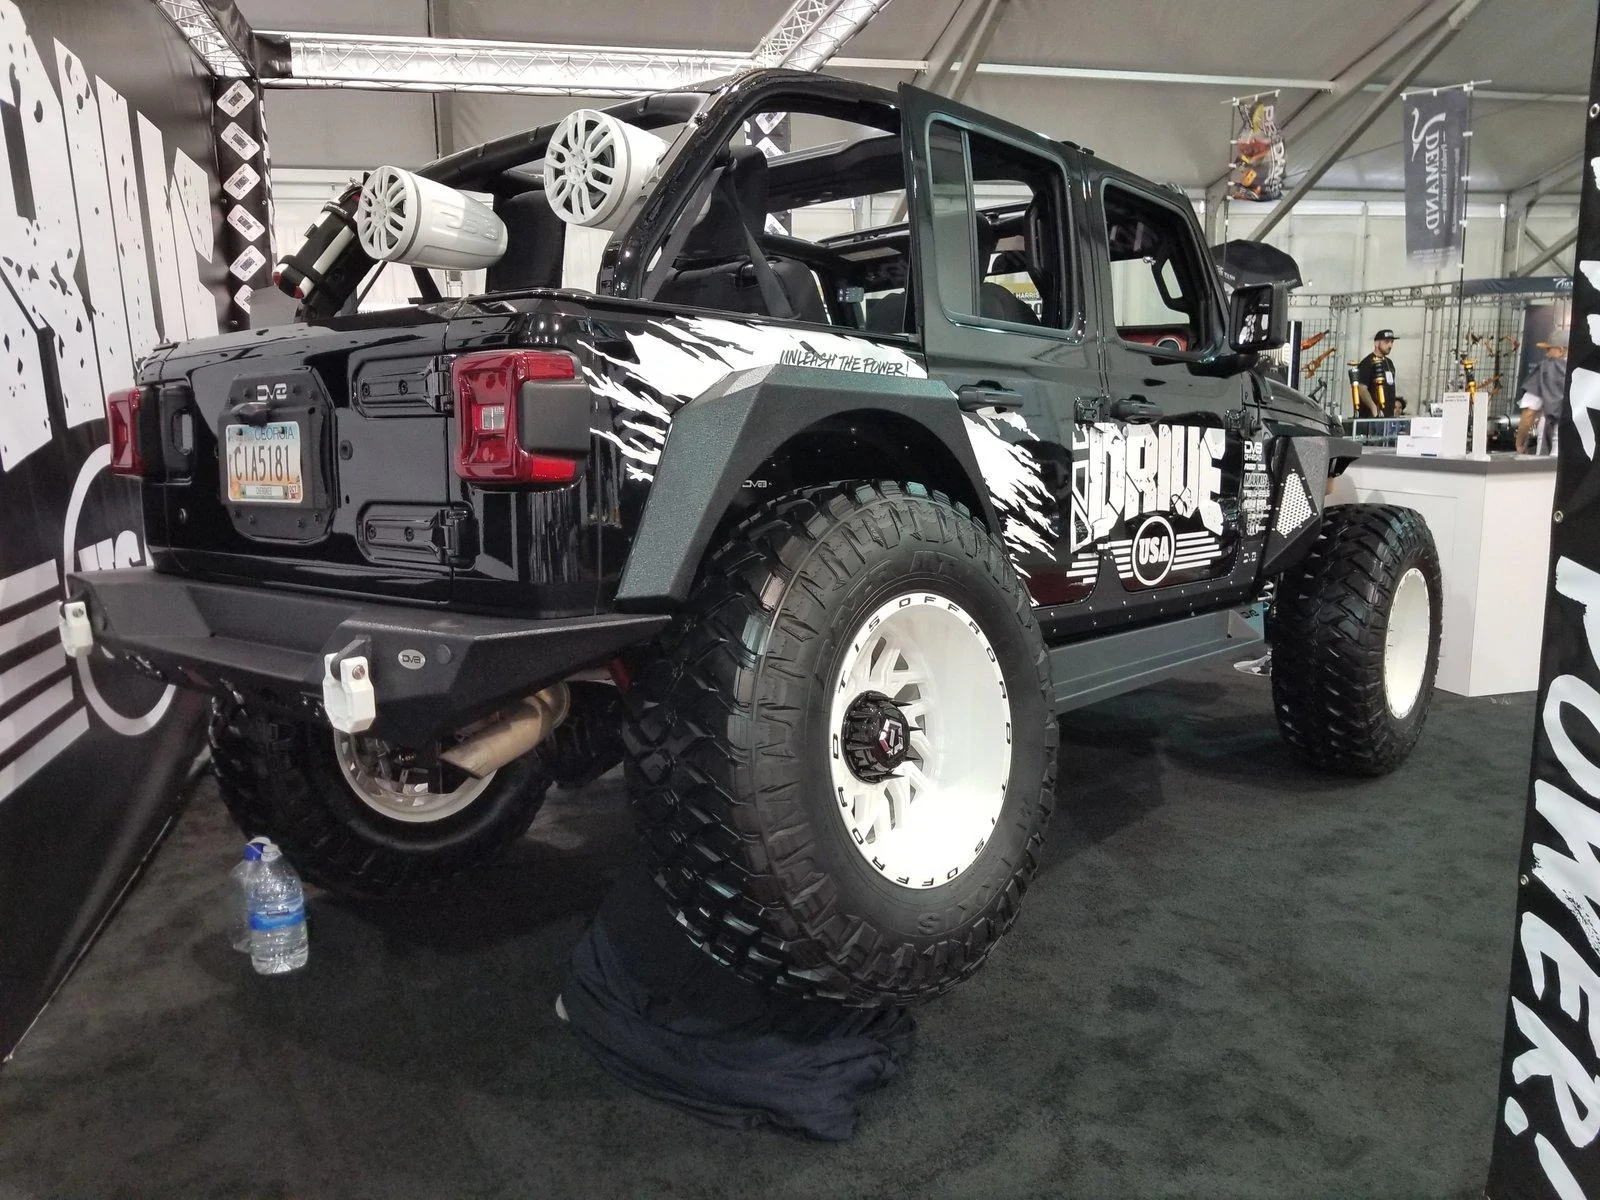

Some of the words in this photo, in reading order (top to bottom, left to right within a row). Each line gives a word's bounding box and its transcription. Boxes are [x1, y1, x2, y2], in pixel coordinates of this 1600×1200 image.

[779, 349, 837, 369] UNLEASH
[839, 355, 861, 371] THE
[863, 357, 909, 377] POWER!
[233, 444, 291, 482] CIA5181
[1138, 535, 1170, 565] USA
